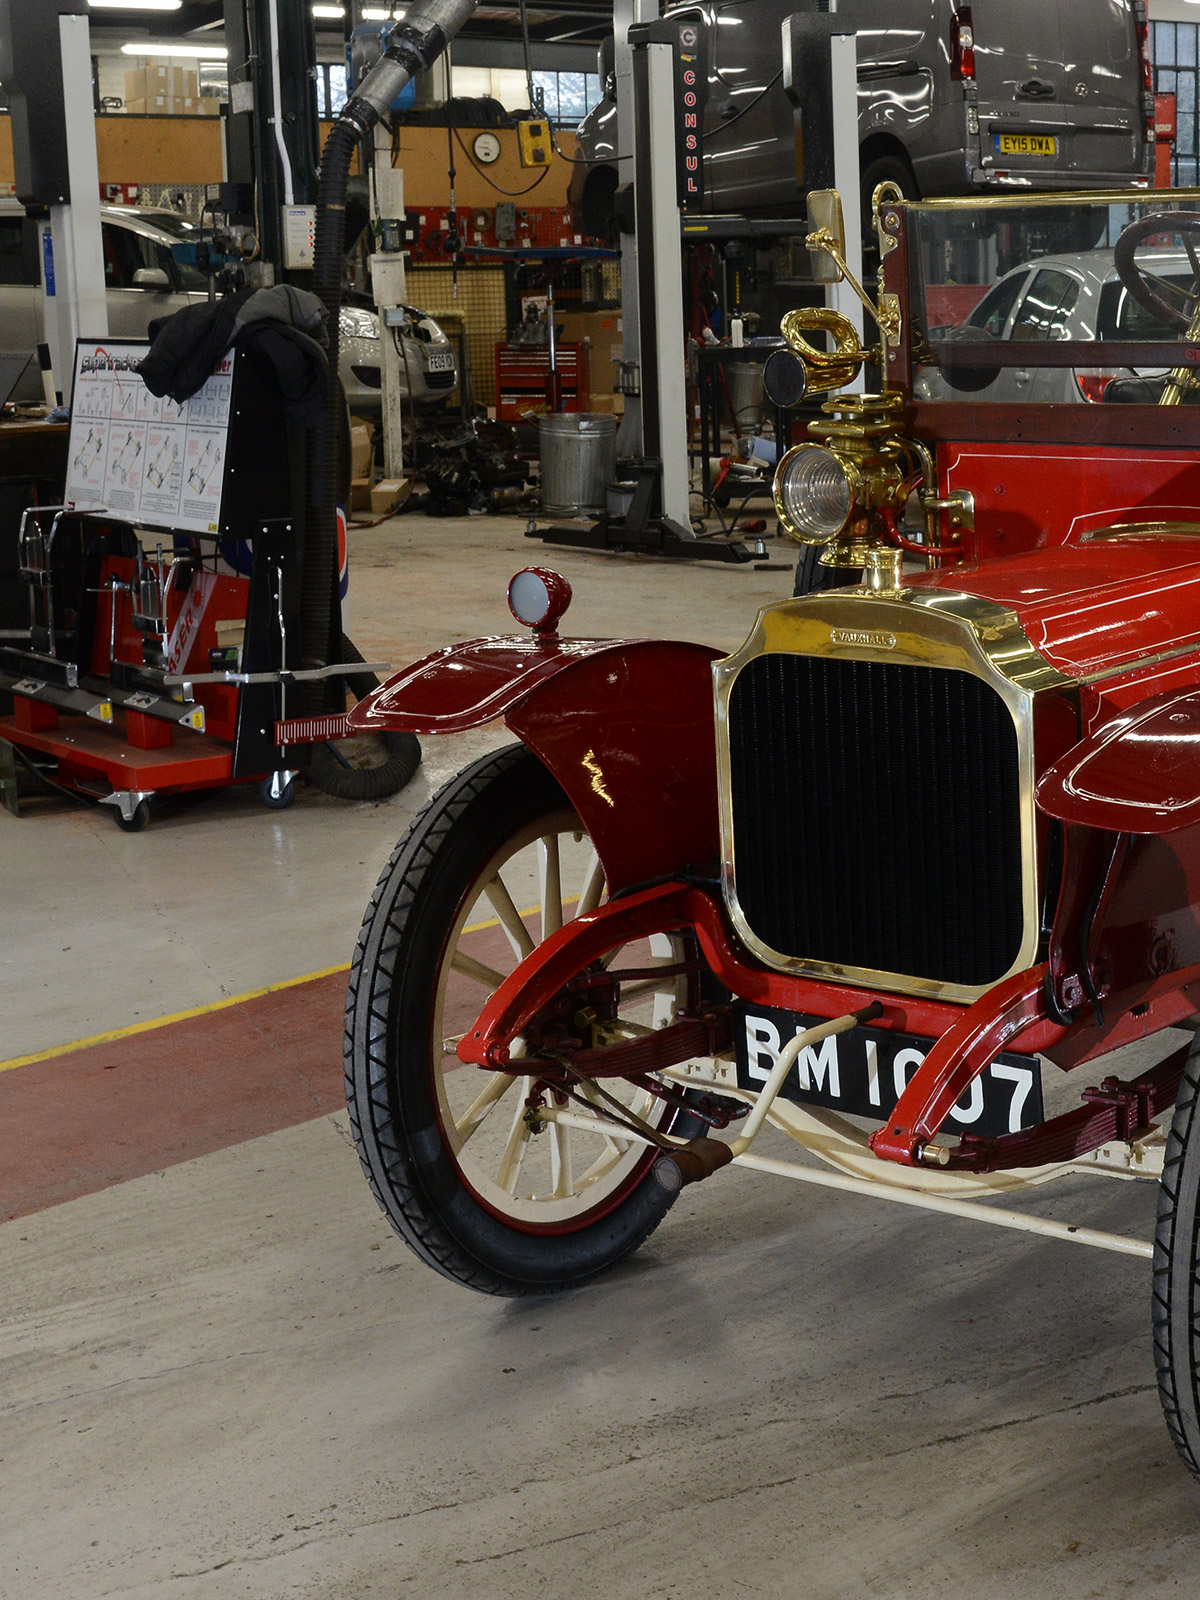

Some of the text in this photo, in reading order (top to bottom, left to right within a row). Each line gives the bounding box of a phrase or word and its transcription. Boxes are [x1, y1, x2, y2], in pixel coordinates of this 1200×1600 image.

[683, 70, 698, 192] CONSUL
[1003, 137, 1051, 151] EY15 DWA
[168, 608, 193, 674] ASER
[839, 632, 887, 644] VAUXHALL
[745, 1014, 841, 1098] BM
